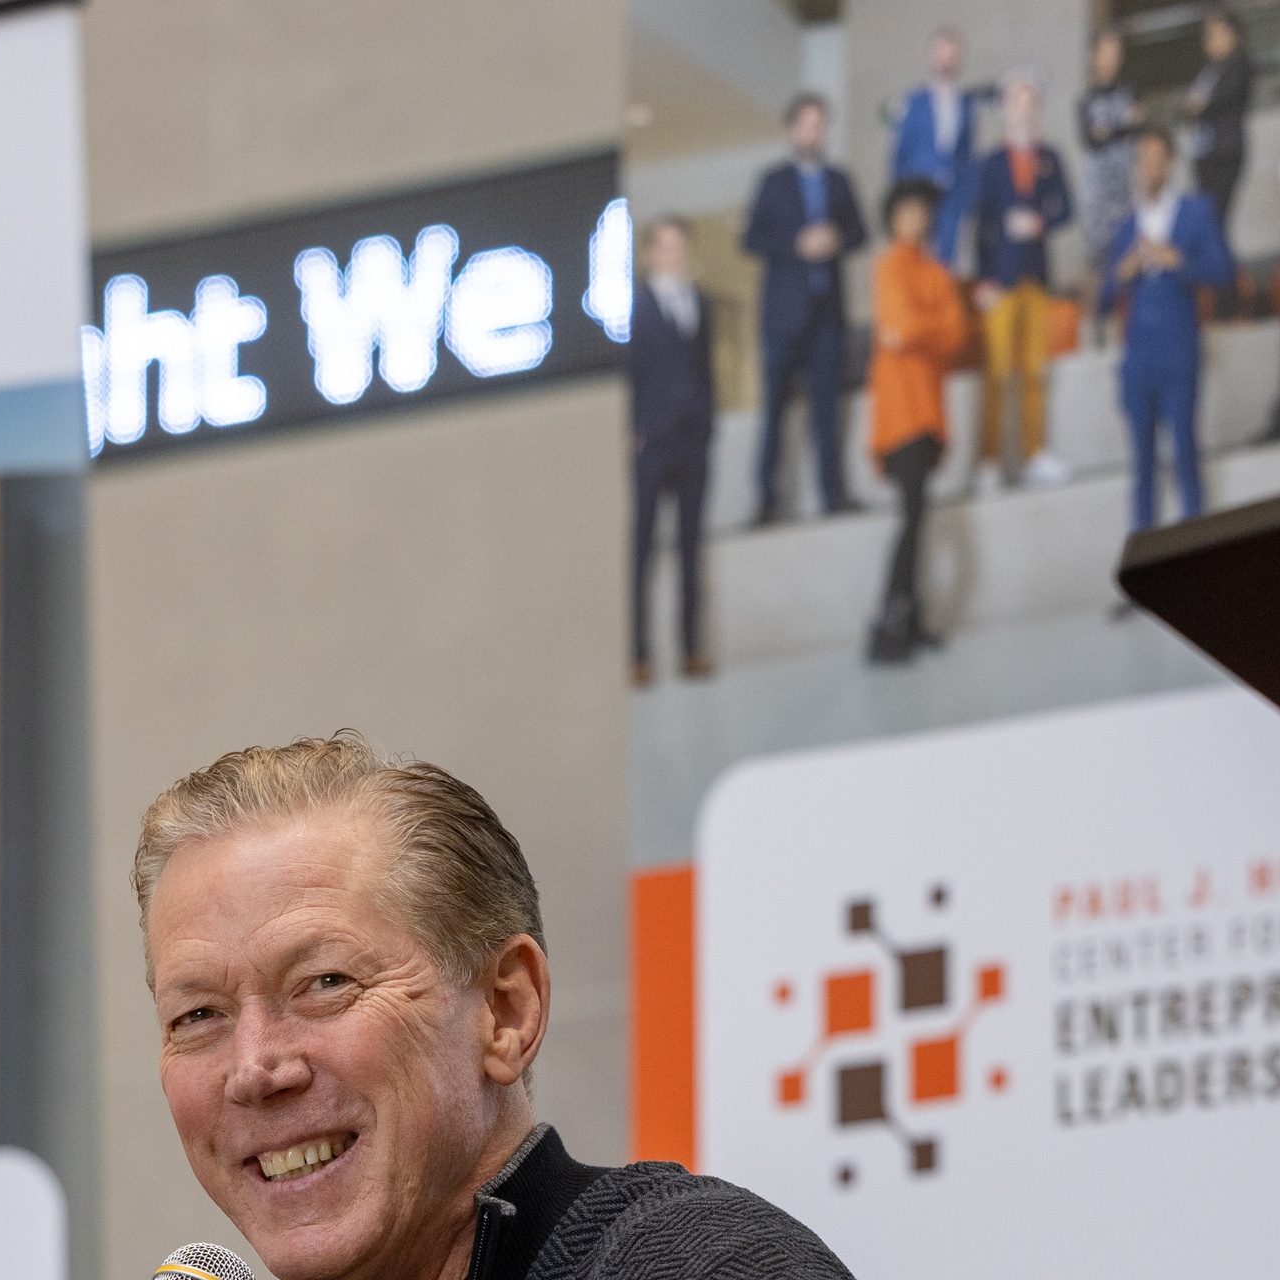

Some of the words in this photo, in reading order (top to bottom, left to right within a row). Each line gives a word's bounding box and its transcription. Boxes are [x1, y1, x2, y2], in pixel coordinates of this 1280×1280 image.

[294, 223, 553, 405] We
[1052, 871, 1162, 925] PAUL
[1051, 921, 1208, 983] CENTER
